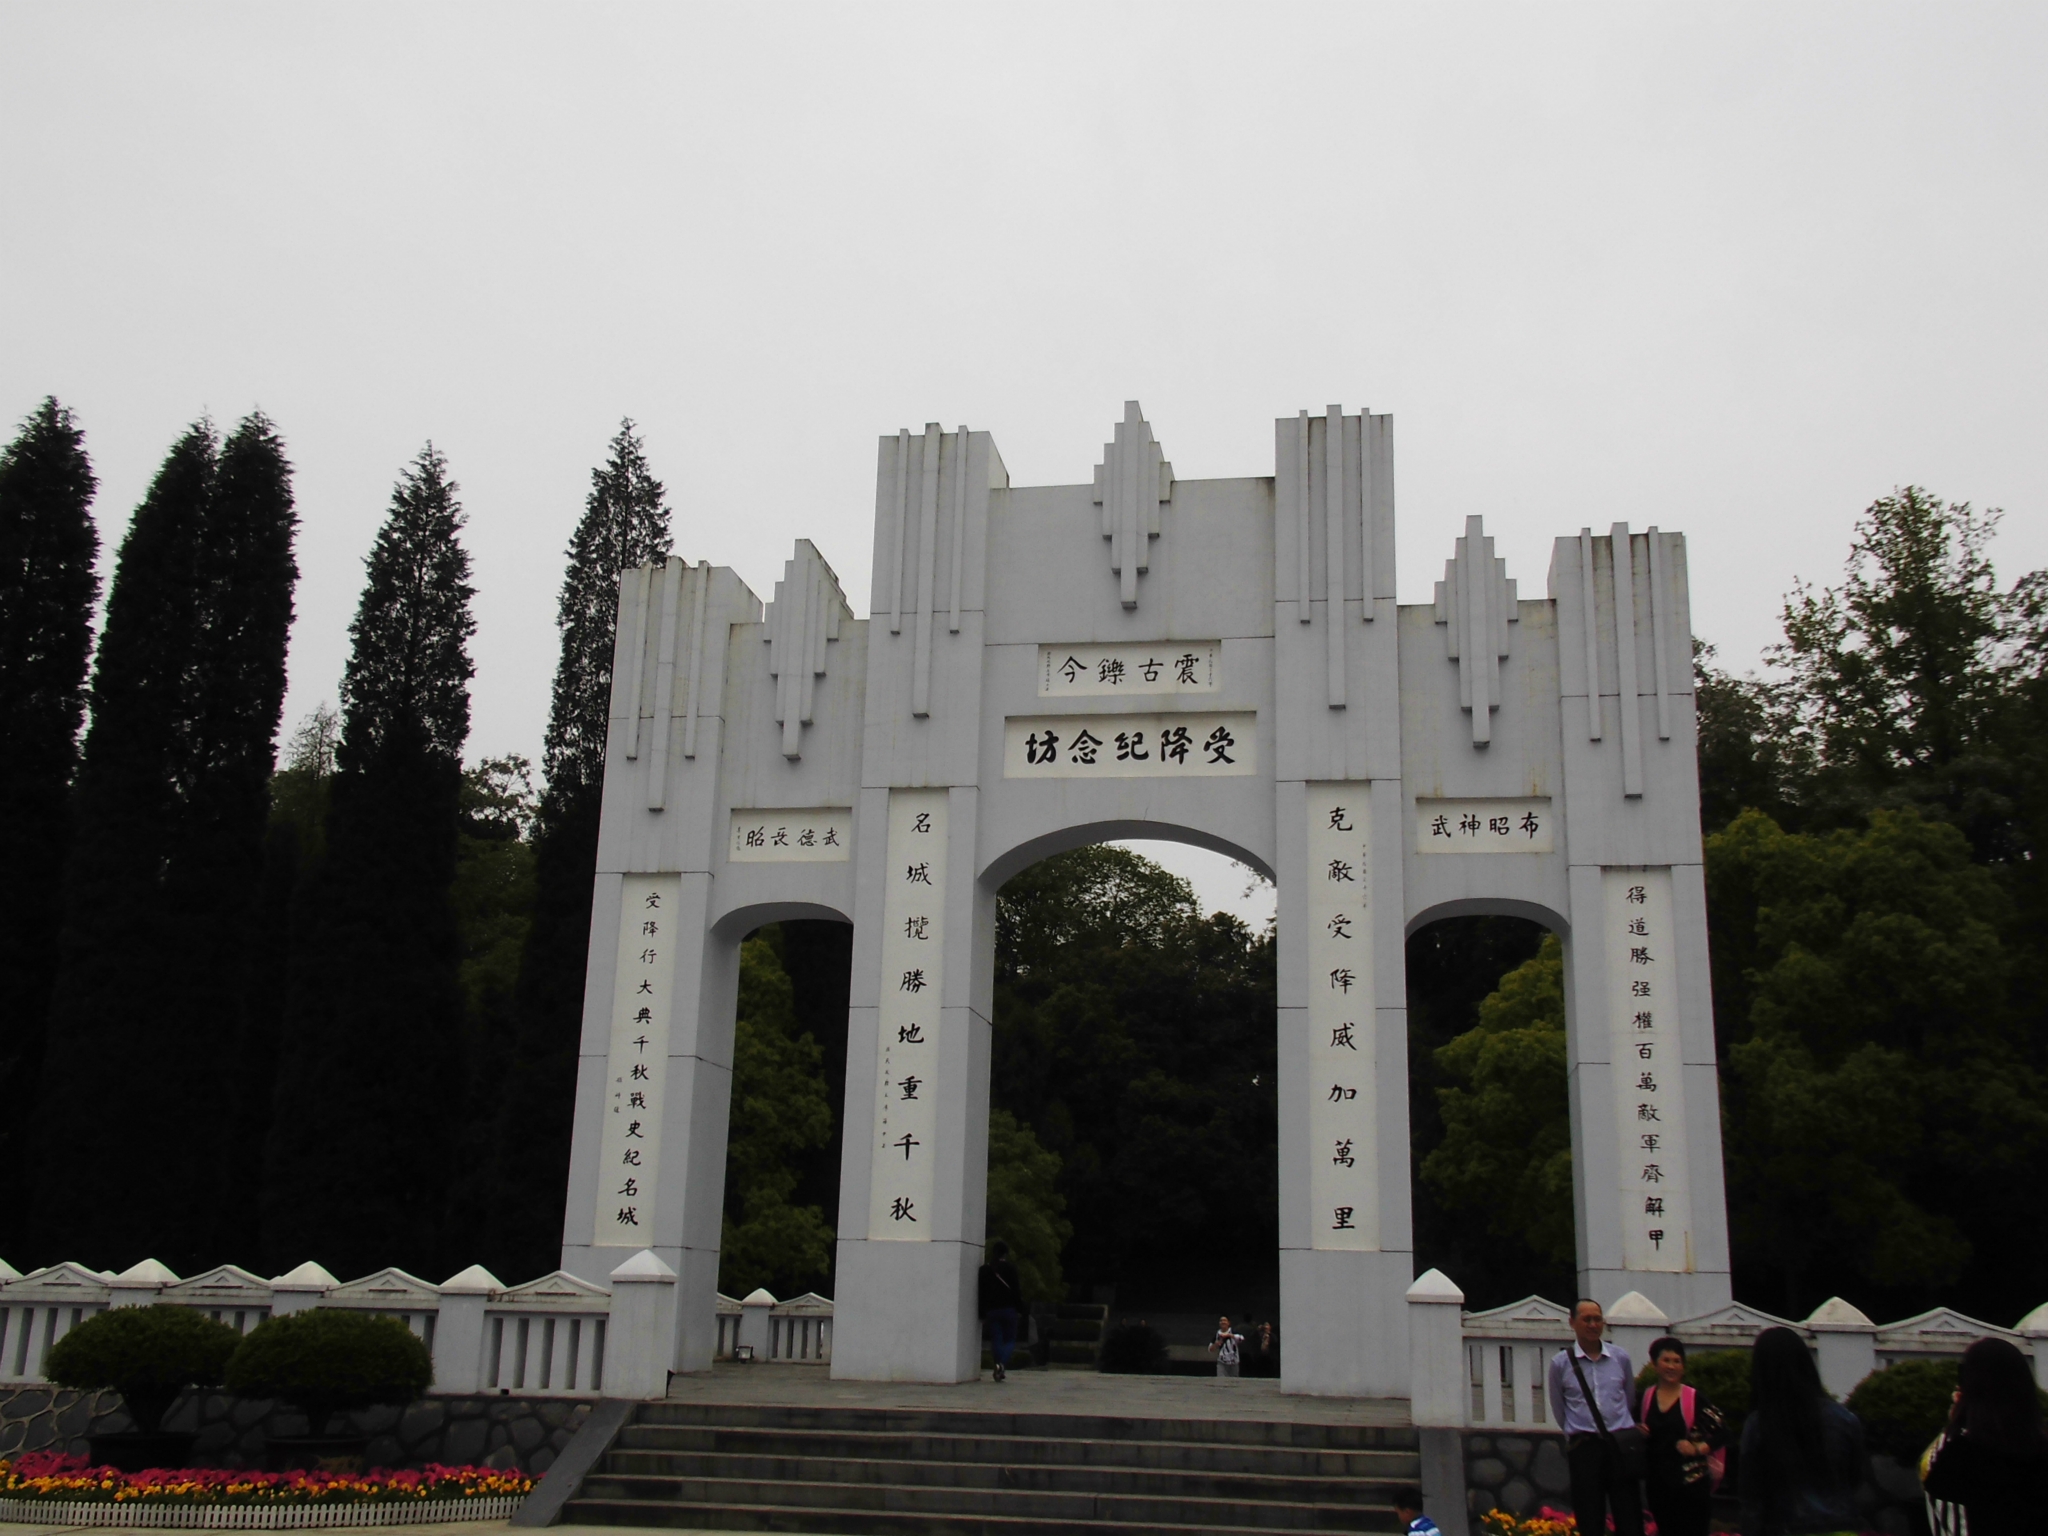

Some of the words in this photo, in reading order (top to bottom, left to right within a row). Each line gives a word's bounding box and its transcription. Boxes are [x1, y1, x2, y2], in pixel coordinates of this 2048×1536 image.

[1431, 811, 1539, 839] 布昭神武
[1328, 806, 1357, 1229] 克敵受降威加萬里
